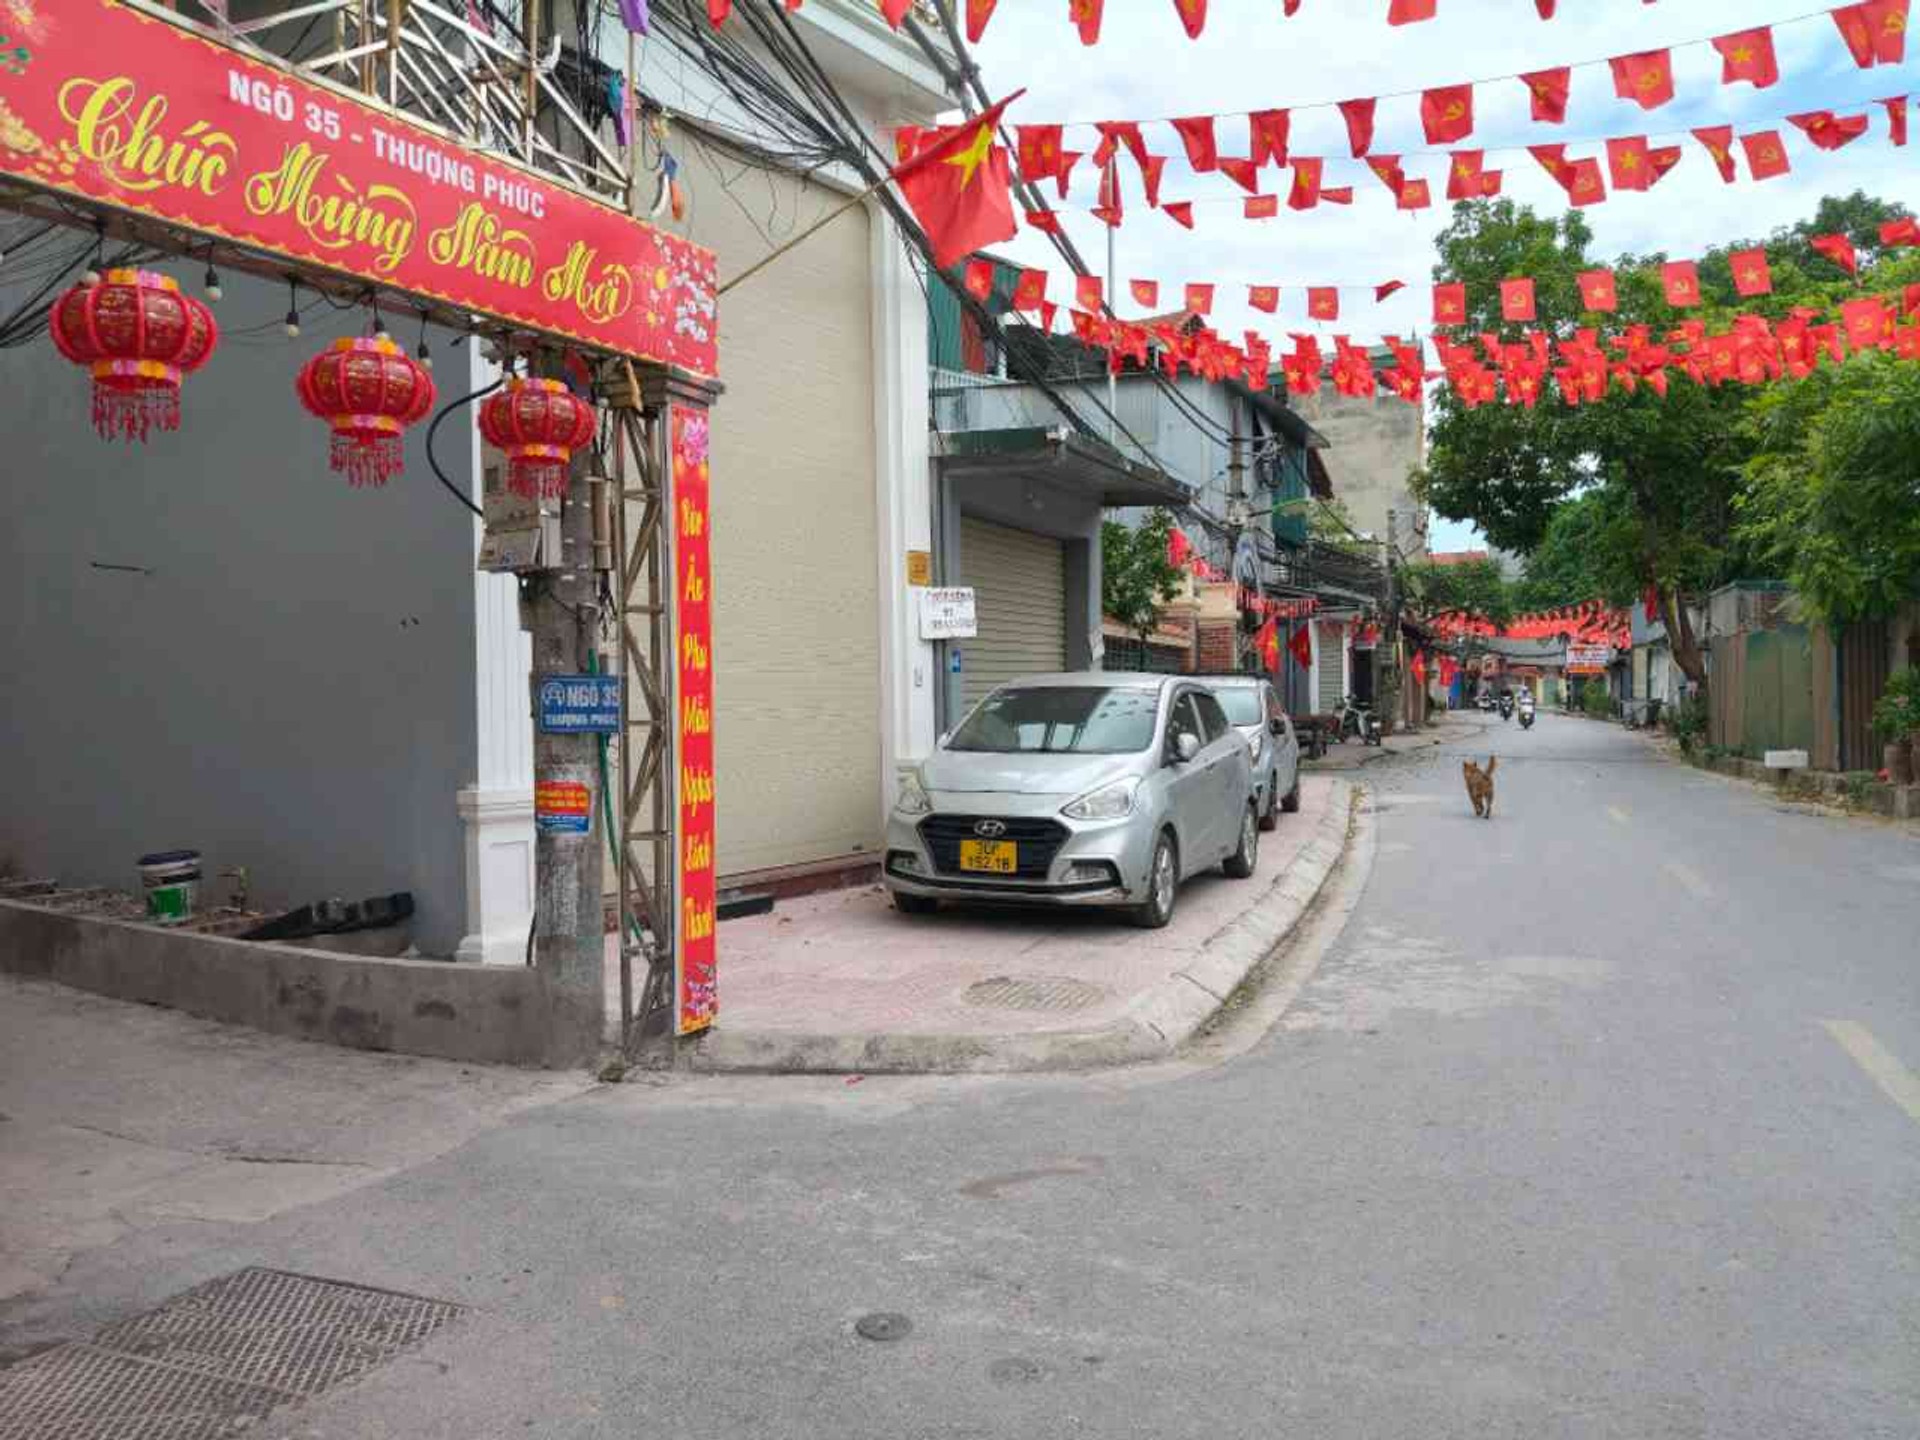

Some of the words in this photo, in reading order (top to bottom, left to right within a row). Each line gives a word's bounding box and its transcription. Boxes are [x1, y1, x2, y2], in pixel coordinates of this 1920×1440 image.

[57, 76, 238, 196] Chúc
[244, 141, 418, 272] Mừng
[228, 69, 294, 122] NGÕ
[304, 101, 342, 141] 35
[371, 127, 477, 194] THƯỢNG
[483, 173, 546, 219] PHÚC
[566, 682, 599, 708] NGÕ
[601, 685, 621, 708] 35
